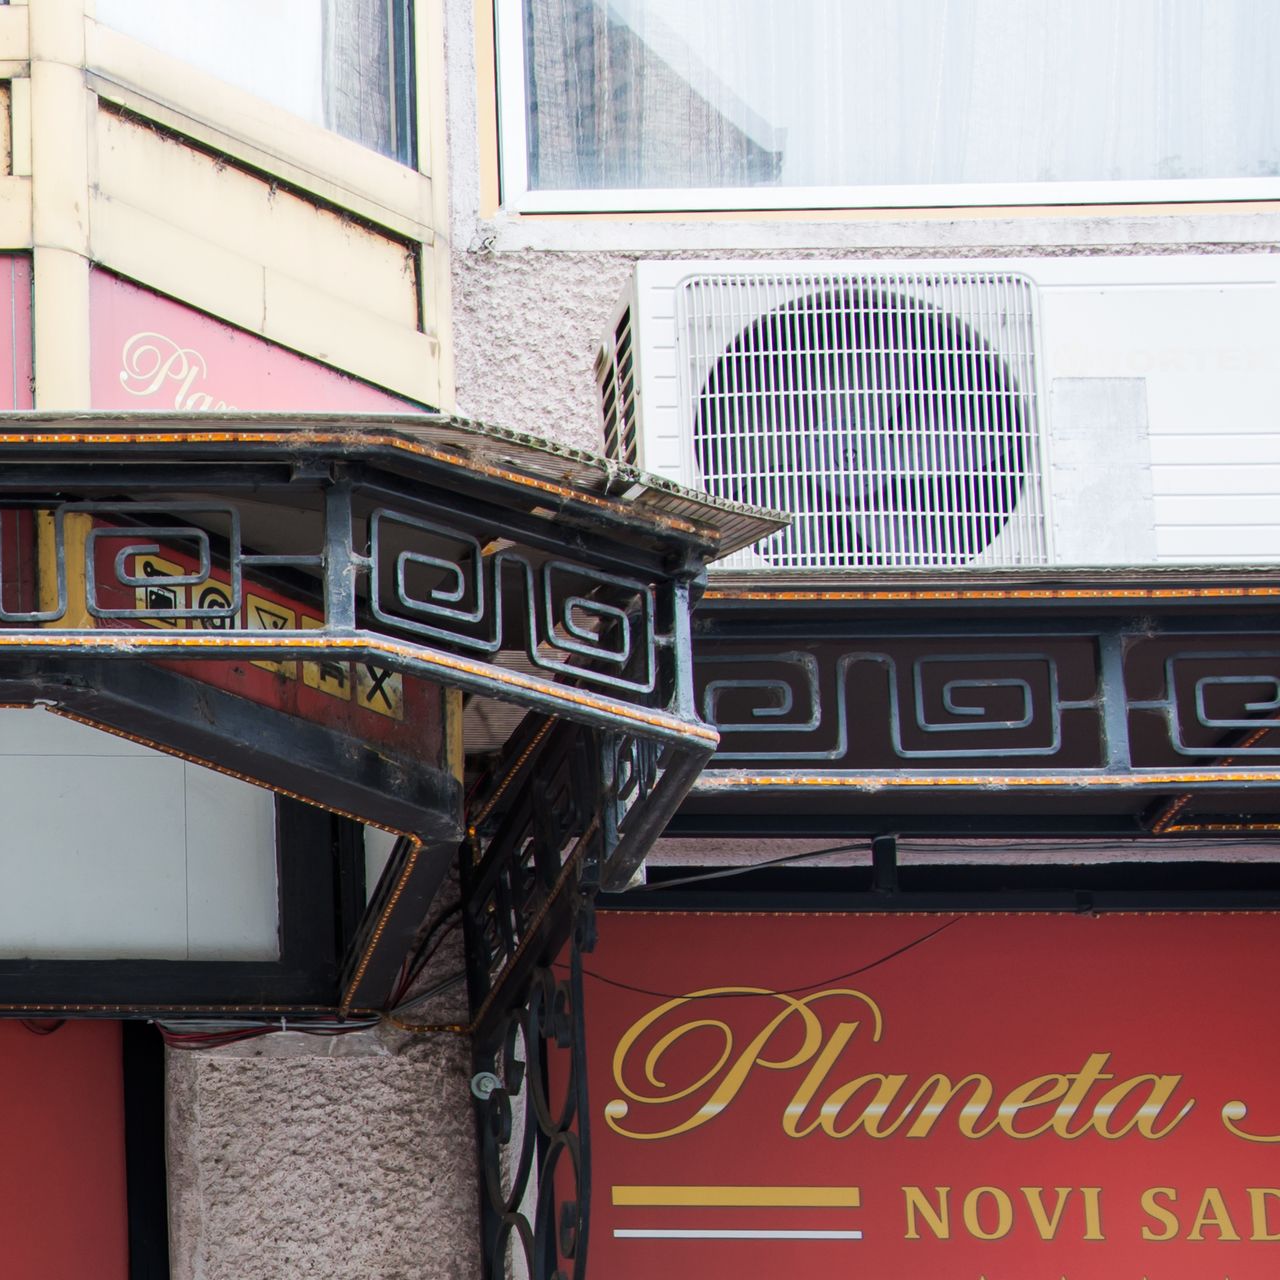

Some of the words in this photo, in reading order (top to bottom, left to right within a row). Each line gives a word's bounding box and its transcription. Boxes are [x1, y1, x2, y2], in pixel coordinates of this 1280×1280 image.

[604, 986, 1197, 1140] Planeta
[901, 1186, 1105, 1241] NOVI
[1141, 1186, 1280, 1242] SAD
